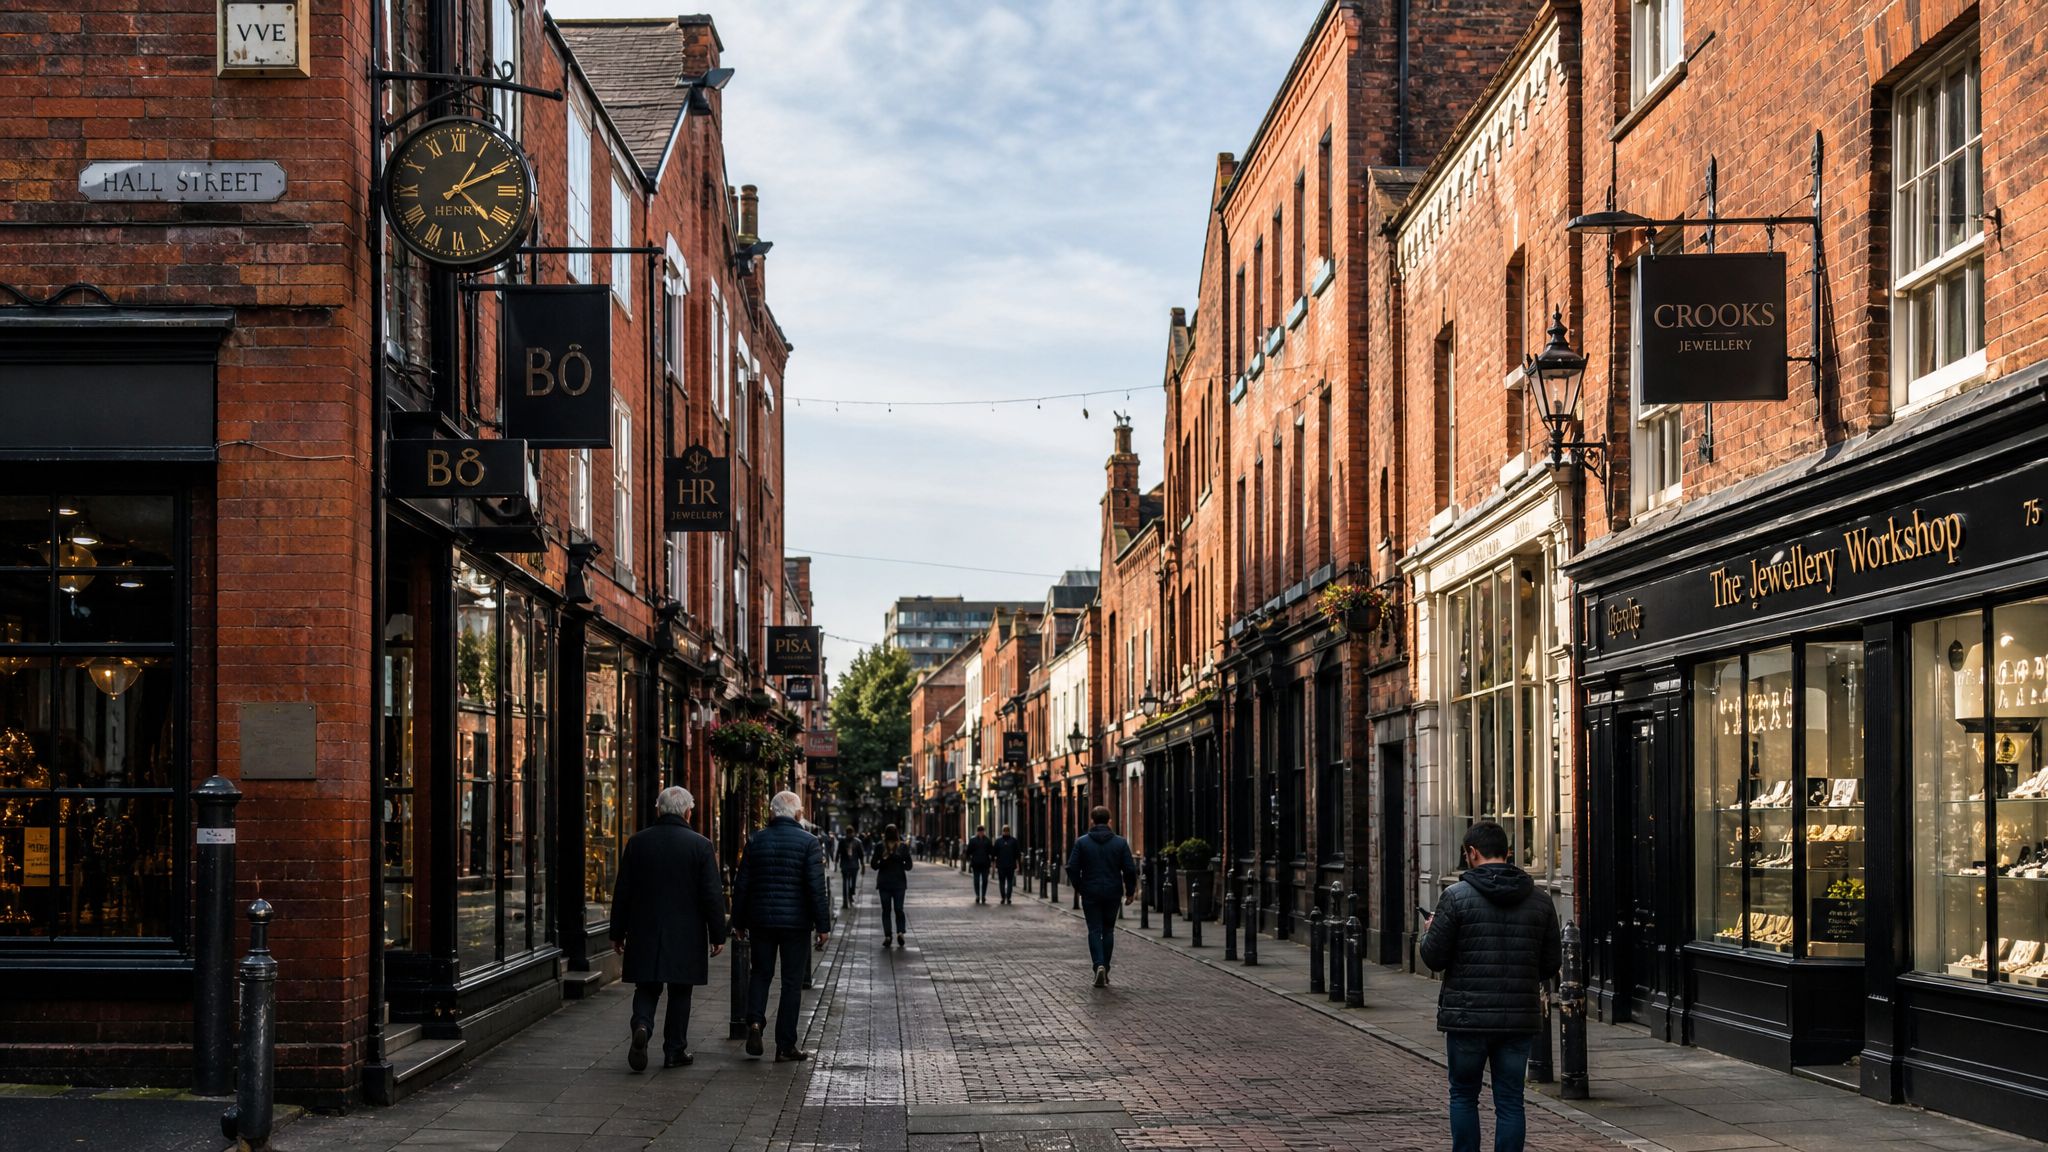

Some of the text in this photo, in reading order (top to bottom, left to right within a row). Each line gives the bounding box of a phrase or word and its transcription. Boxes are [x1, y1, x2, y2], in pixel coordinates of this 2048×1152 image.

[237, 23, 287, 42] VVE
[426, 139, 443, 159] XI
[452, 134, 466, 152] XII
[407, 160, 425, 174] X
[103, 172, 263, 193] HALL STREET
[400, 183, 419, 198] IX
[498, 185, 517, 197] III
[434, 204, 482, 217] HENRY
[452, 231, 466, 251] VI
[477, 226, 490, 244] V
[1653, 302, 1776, 329] CROOKS
[1677, 339, 1753, 354] JEWELLERY
[678, 478, 719, 505] HR
[671, 511, 725, 521] JEWELLERY
[2023, 497, 2041, 527] 75
[1709, 508, 1962, 609] The Jewellery Workshop
[775, 638, 812, 653] PISA
